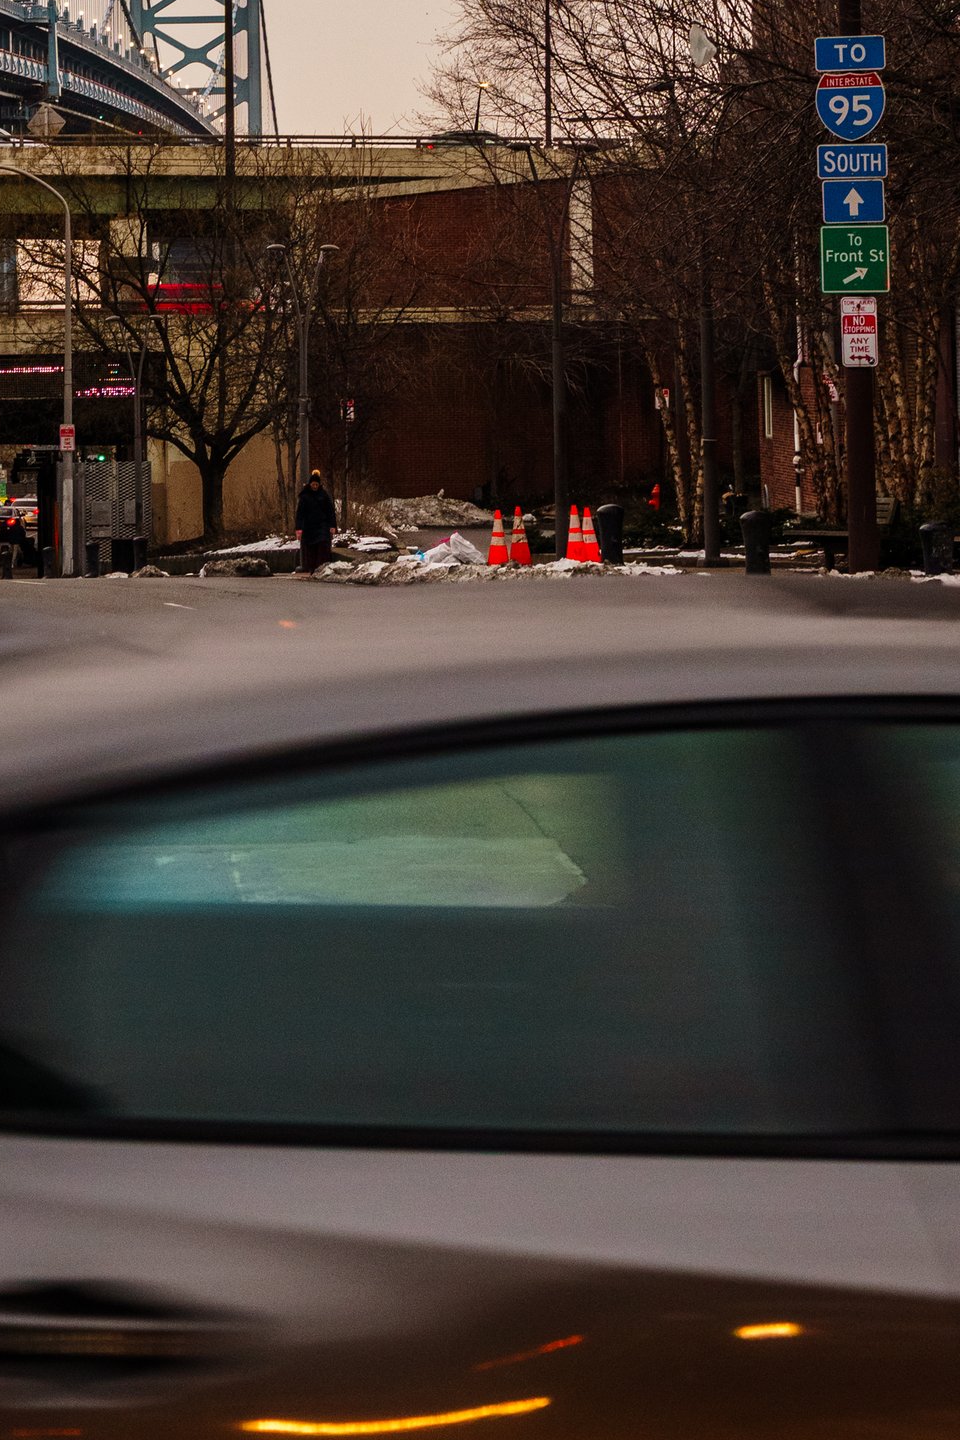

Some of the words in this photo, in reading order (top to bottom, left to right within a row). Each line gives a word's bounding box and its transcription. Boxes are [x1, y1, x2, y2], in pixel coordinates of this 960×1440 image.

[834, 44, 866, 63] TO
[826, 76, 873, 87] INTERSTATE
[828, 94, 873, 126] 95
[823, 150, 882, 173] SOUTH
[847, 233, 862, 247] To
[826, 249, 863, 262] Front
[869, 249, 884, 262] St
[852, 315, 866, 326] NO
[844, 325, 875, 334] STOPPING
[850, 337, 869, 345] ANY
